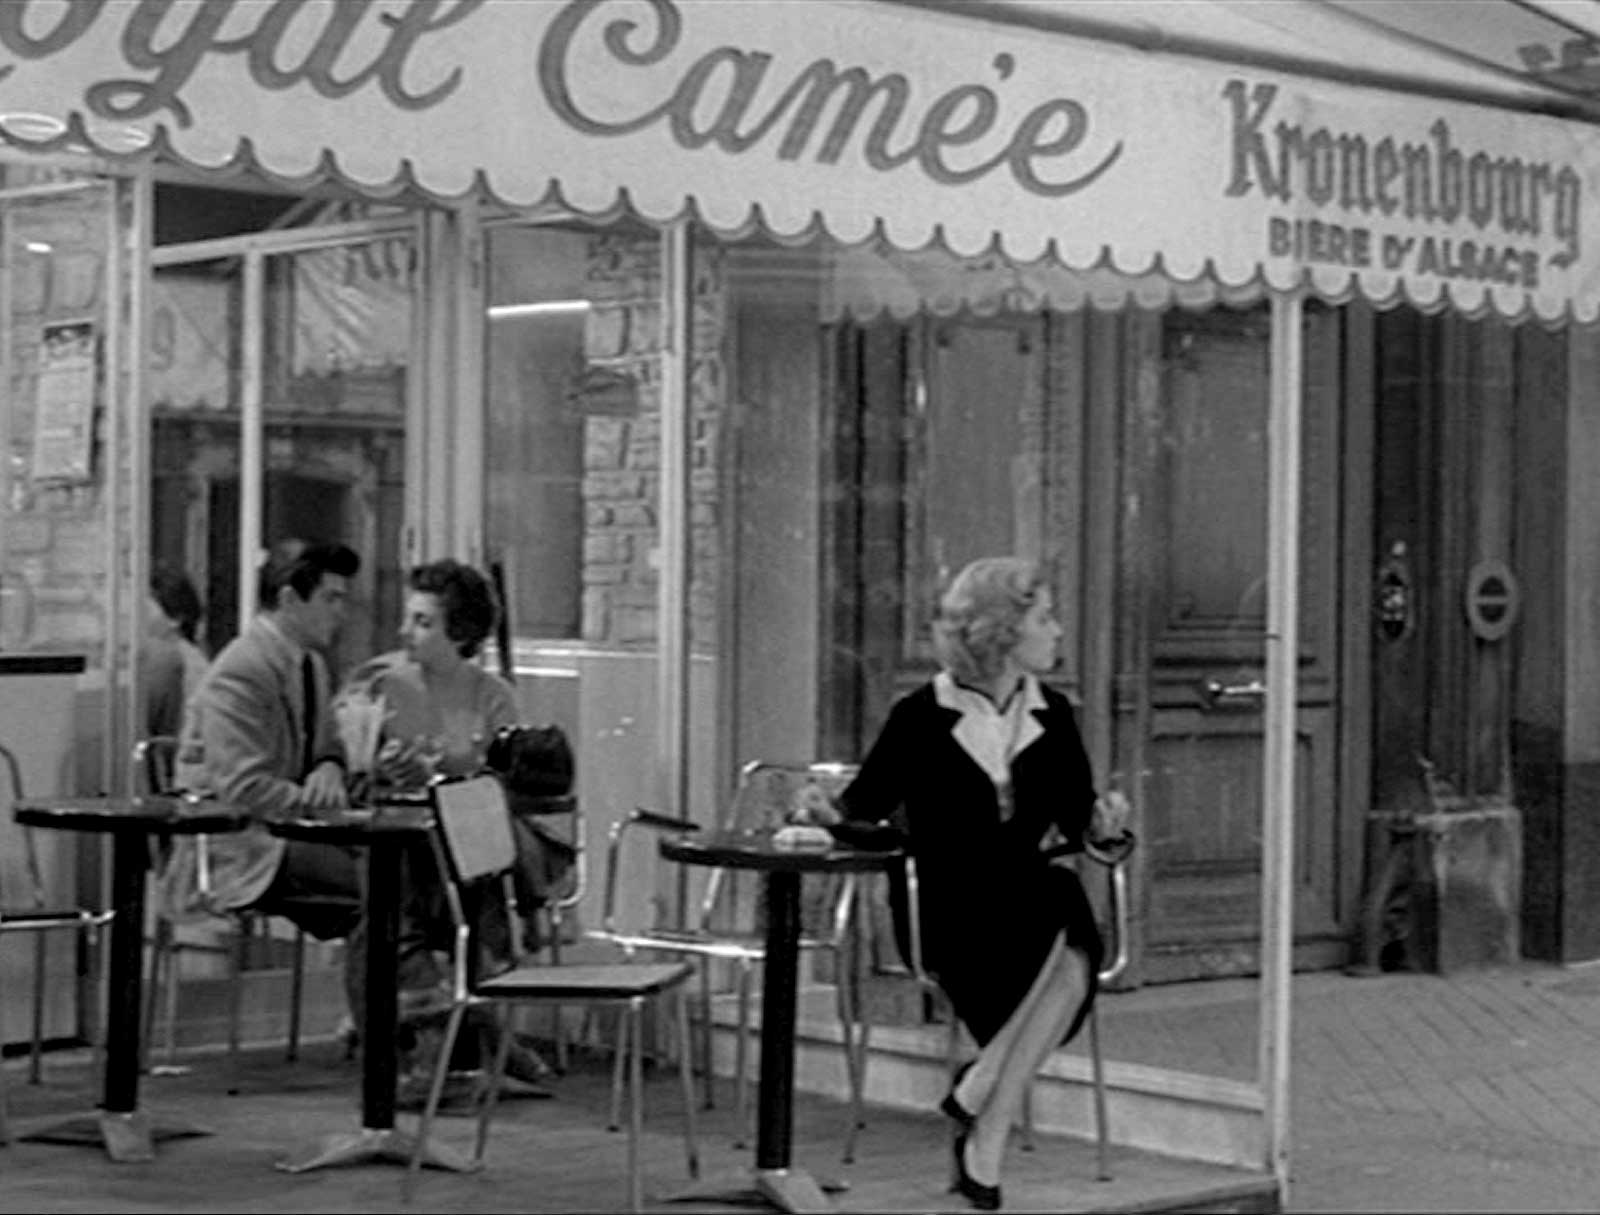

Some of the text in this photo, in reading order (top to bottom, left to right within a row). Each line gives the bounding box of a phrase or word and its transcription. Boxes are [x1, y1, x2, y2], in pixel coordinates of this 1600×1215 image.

[536, 0, 1124, 197] Camée
[1221, 78, 1582, 270] Kronenbourg
[1268, 216, 1371, 268] BIERE
